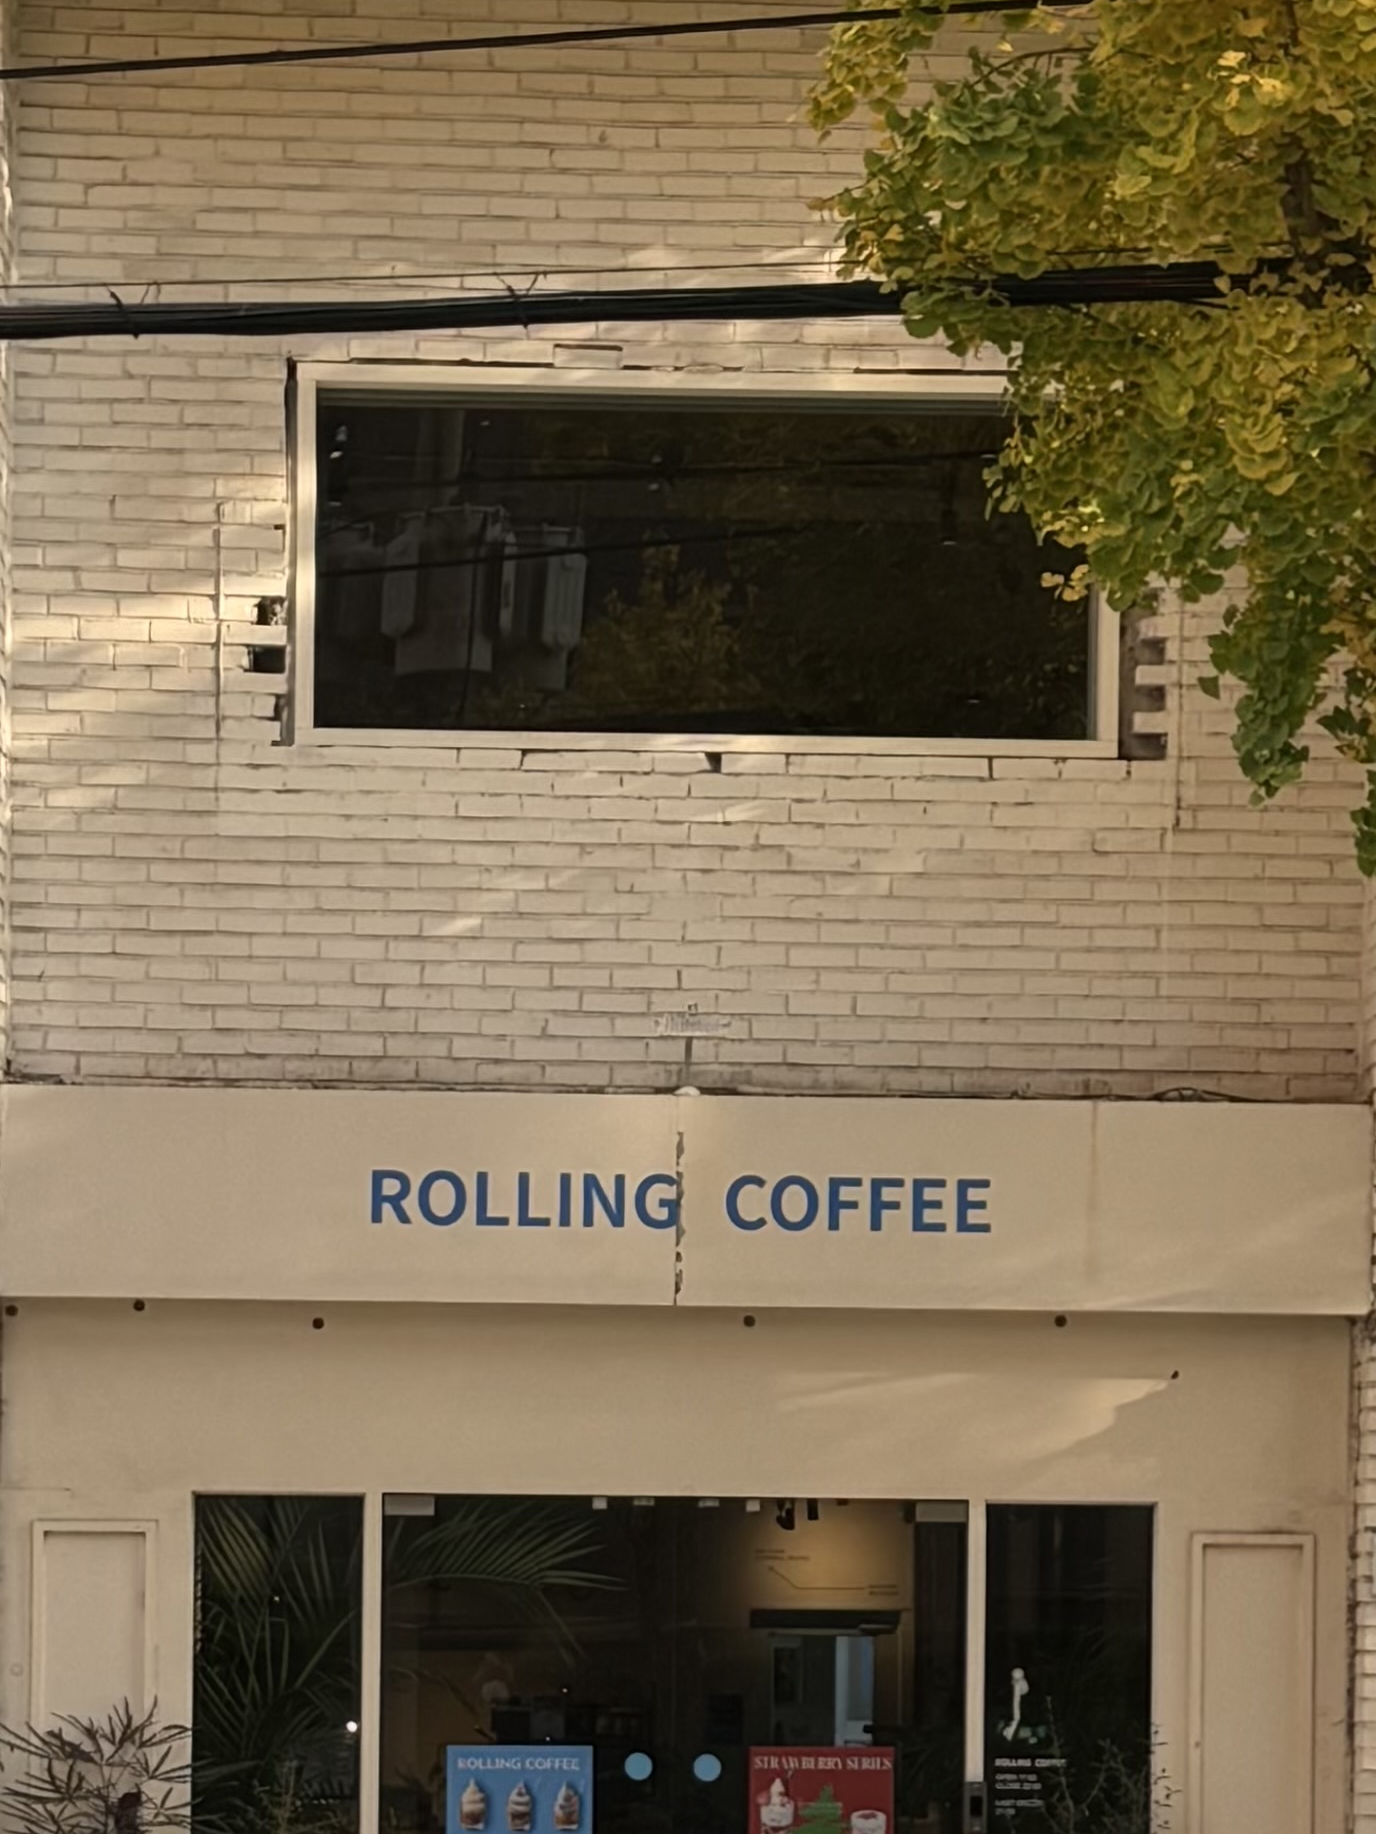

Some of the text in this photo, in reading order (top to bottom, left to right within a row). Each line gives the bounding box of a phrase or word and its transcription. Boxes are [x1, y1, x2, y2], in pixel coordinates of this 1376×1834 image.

[370, 1169, 992, 1233] ROLLING COFFEE
[457, 1758, 580, 1770] ROLLING COFFEE
